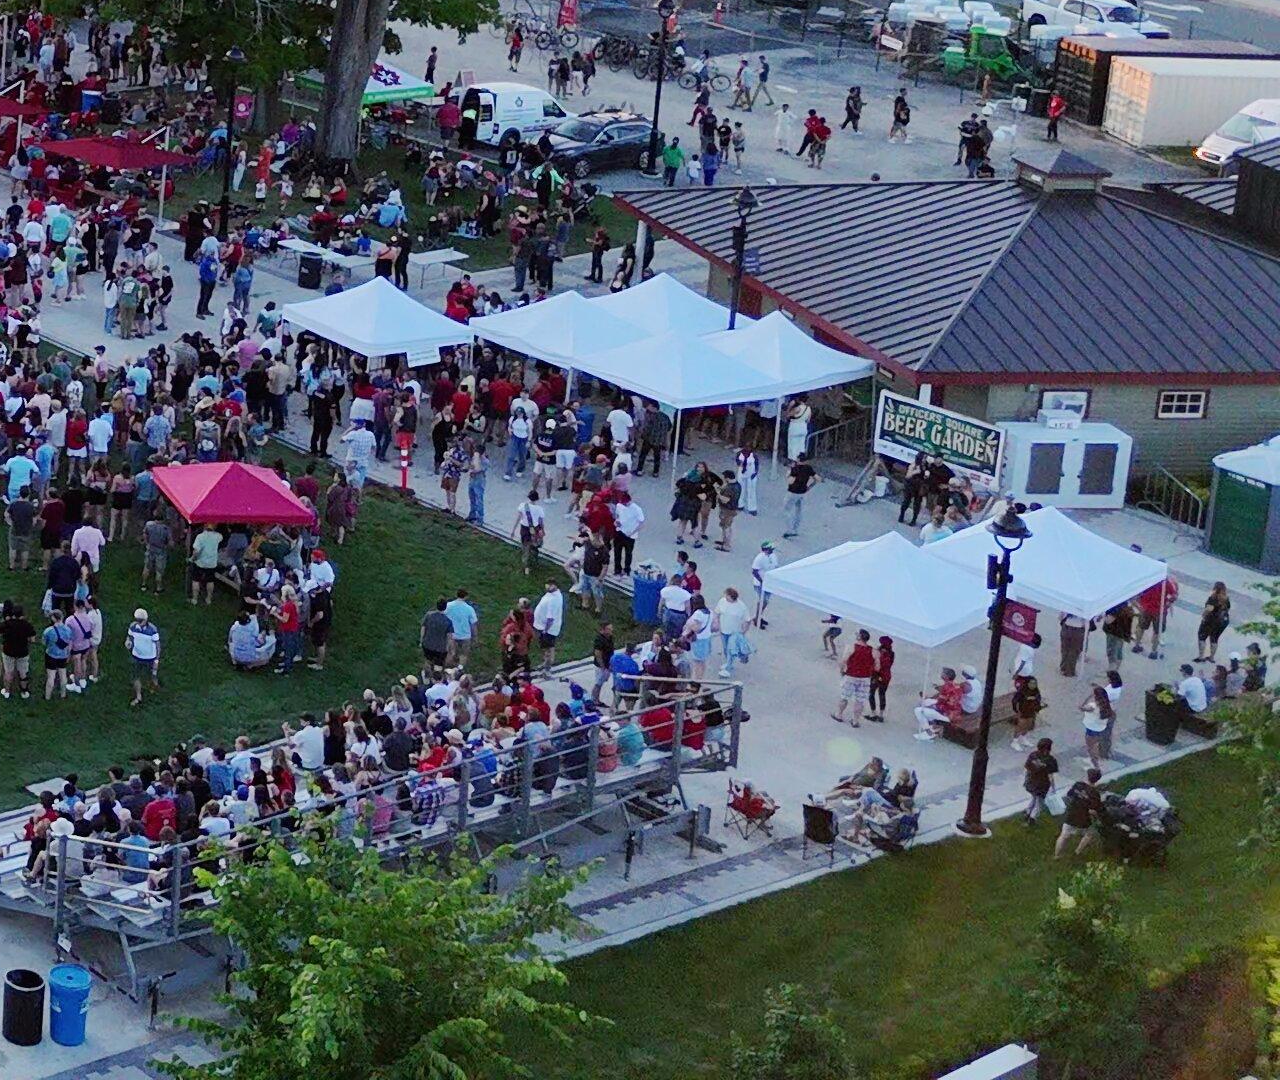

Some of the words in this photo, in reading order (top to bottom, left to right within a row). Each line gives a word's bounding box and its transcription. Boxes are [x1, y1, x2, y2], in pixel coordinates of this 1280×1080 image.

[883, 412, 928, 441] BEER
[930, 423, 996, 466] GARDEN
[945, 417, 984, 440] SQUARE
